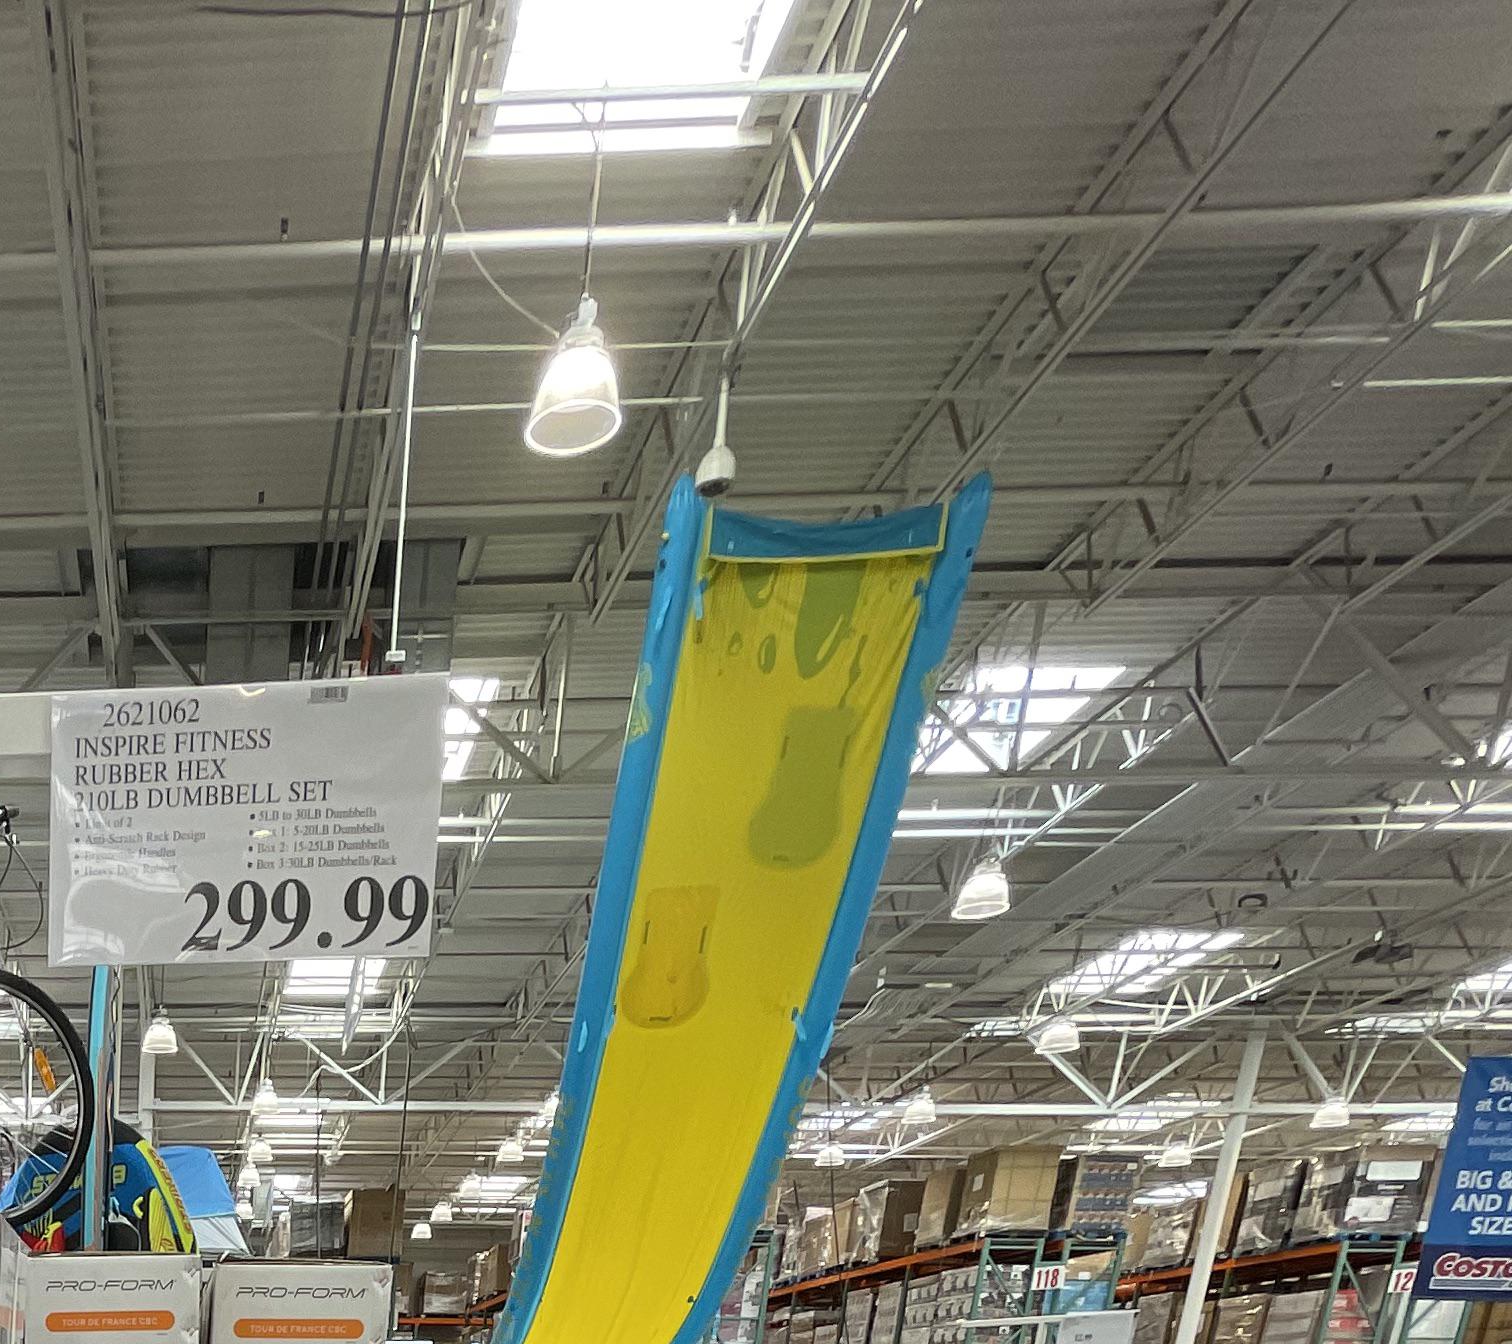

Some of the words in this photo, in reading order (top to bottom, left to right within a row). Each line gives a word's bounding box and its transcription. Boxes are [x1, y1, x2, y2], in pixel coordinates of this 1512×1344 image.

[103, 698, 200, 727] 2621062
[74, 733, 166, 759] INSPIRE
[174, 727, 272, 754] FITNESS
[74, 760, 168, 786] RUBBER
[176, 758, 228, 781] HEX
[74, 787, 139, 811] 210LB
[147, 782, 281, 809] DUMBBELL
[288, 779, 333, 803] SET
[180, 875, 429, 952] 299.99
[1456, 1170, 1491, 1190] BIG
[1451, 1194, 1502, 1213] AND
[45, 1279, 175, 1293] PRO-FORM
[1036, 1268, 1059, 1289] 118
[236, 1286, 367, 1300] PRO-FORM
[62, 1318, 86, 1327] TOUR
[102, 1317, 137, 1327] FRANCE
[250, 1325, 273, 1334] TOUR
[290, 1325, 325, 1334] FRANCE
